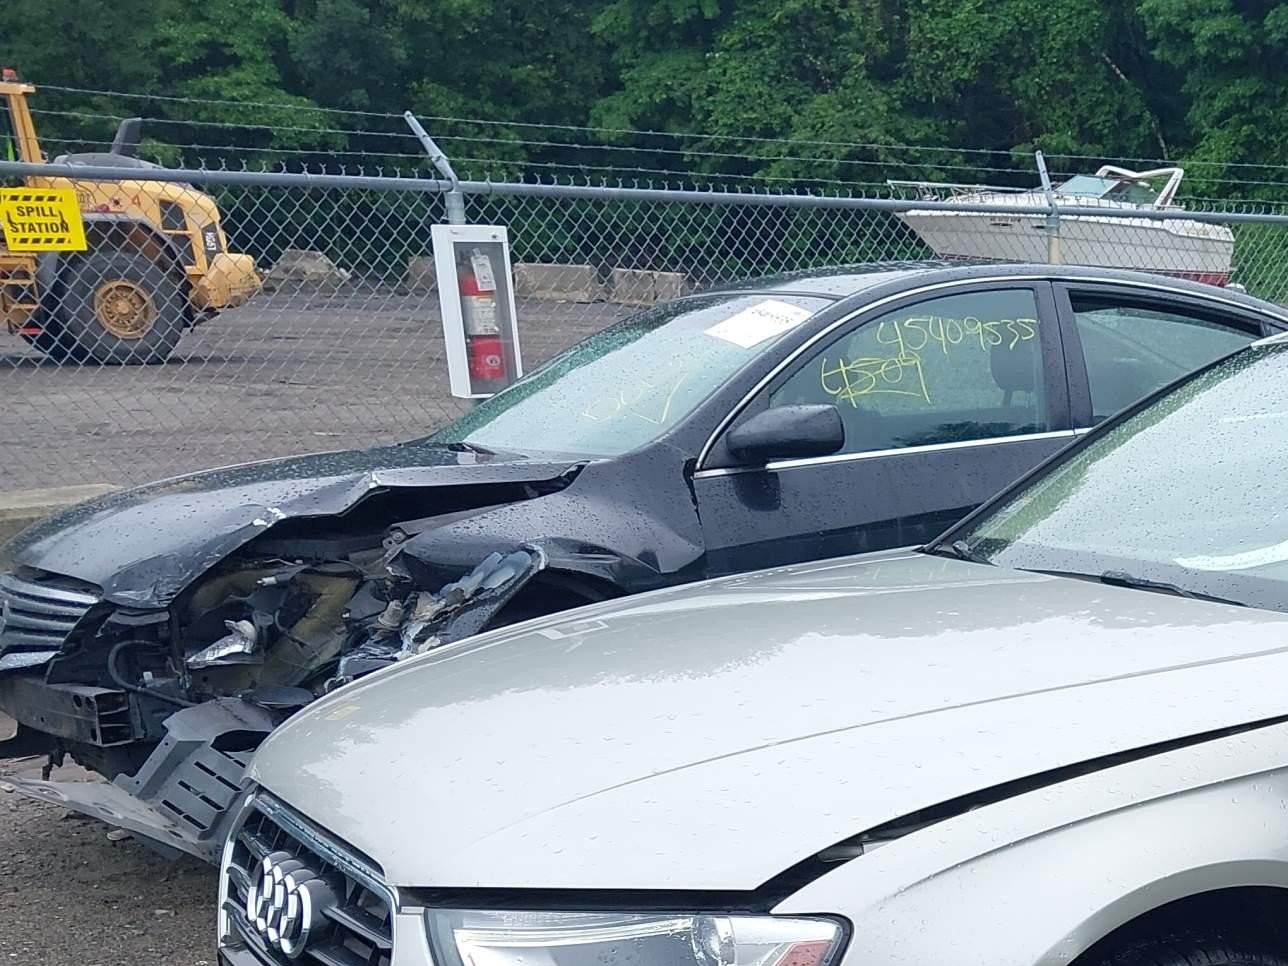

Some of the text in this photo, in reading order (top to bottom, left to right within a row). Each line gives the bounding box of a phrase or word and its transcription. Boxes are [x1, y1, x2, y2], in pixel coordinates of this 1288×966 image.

[16, 205, 58, 218] SPILL
[10, 222, 70, 234] STATION
[876, 315, 1041, 359] 45409535
